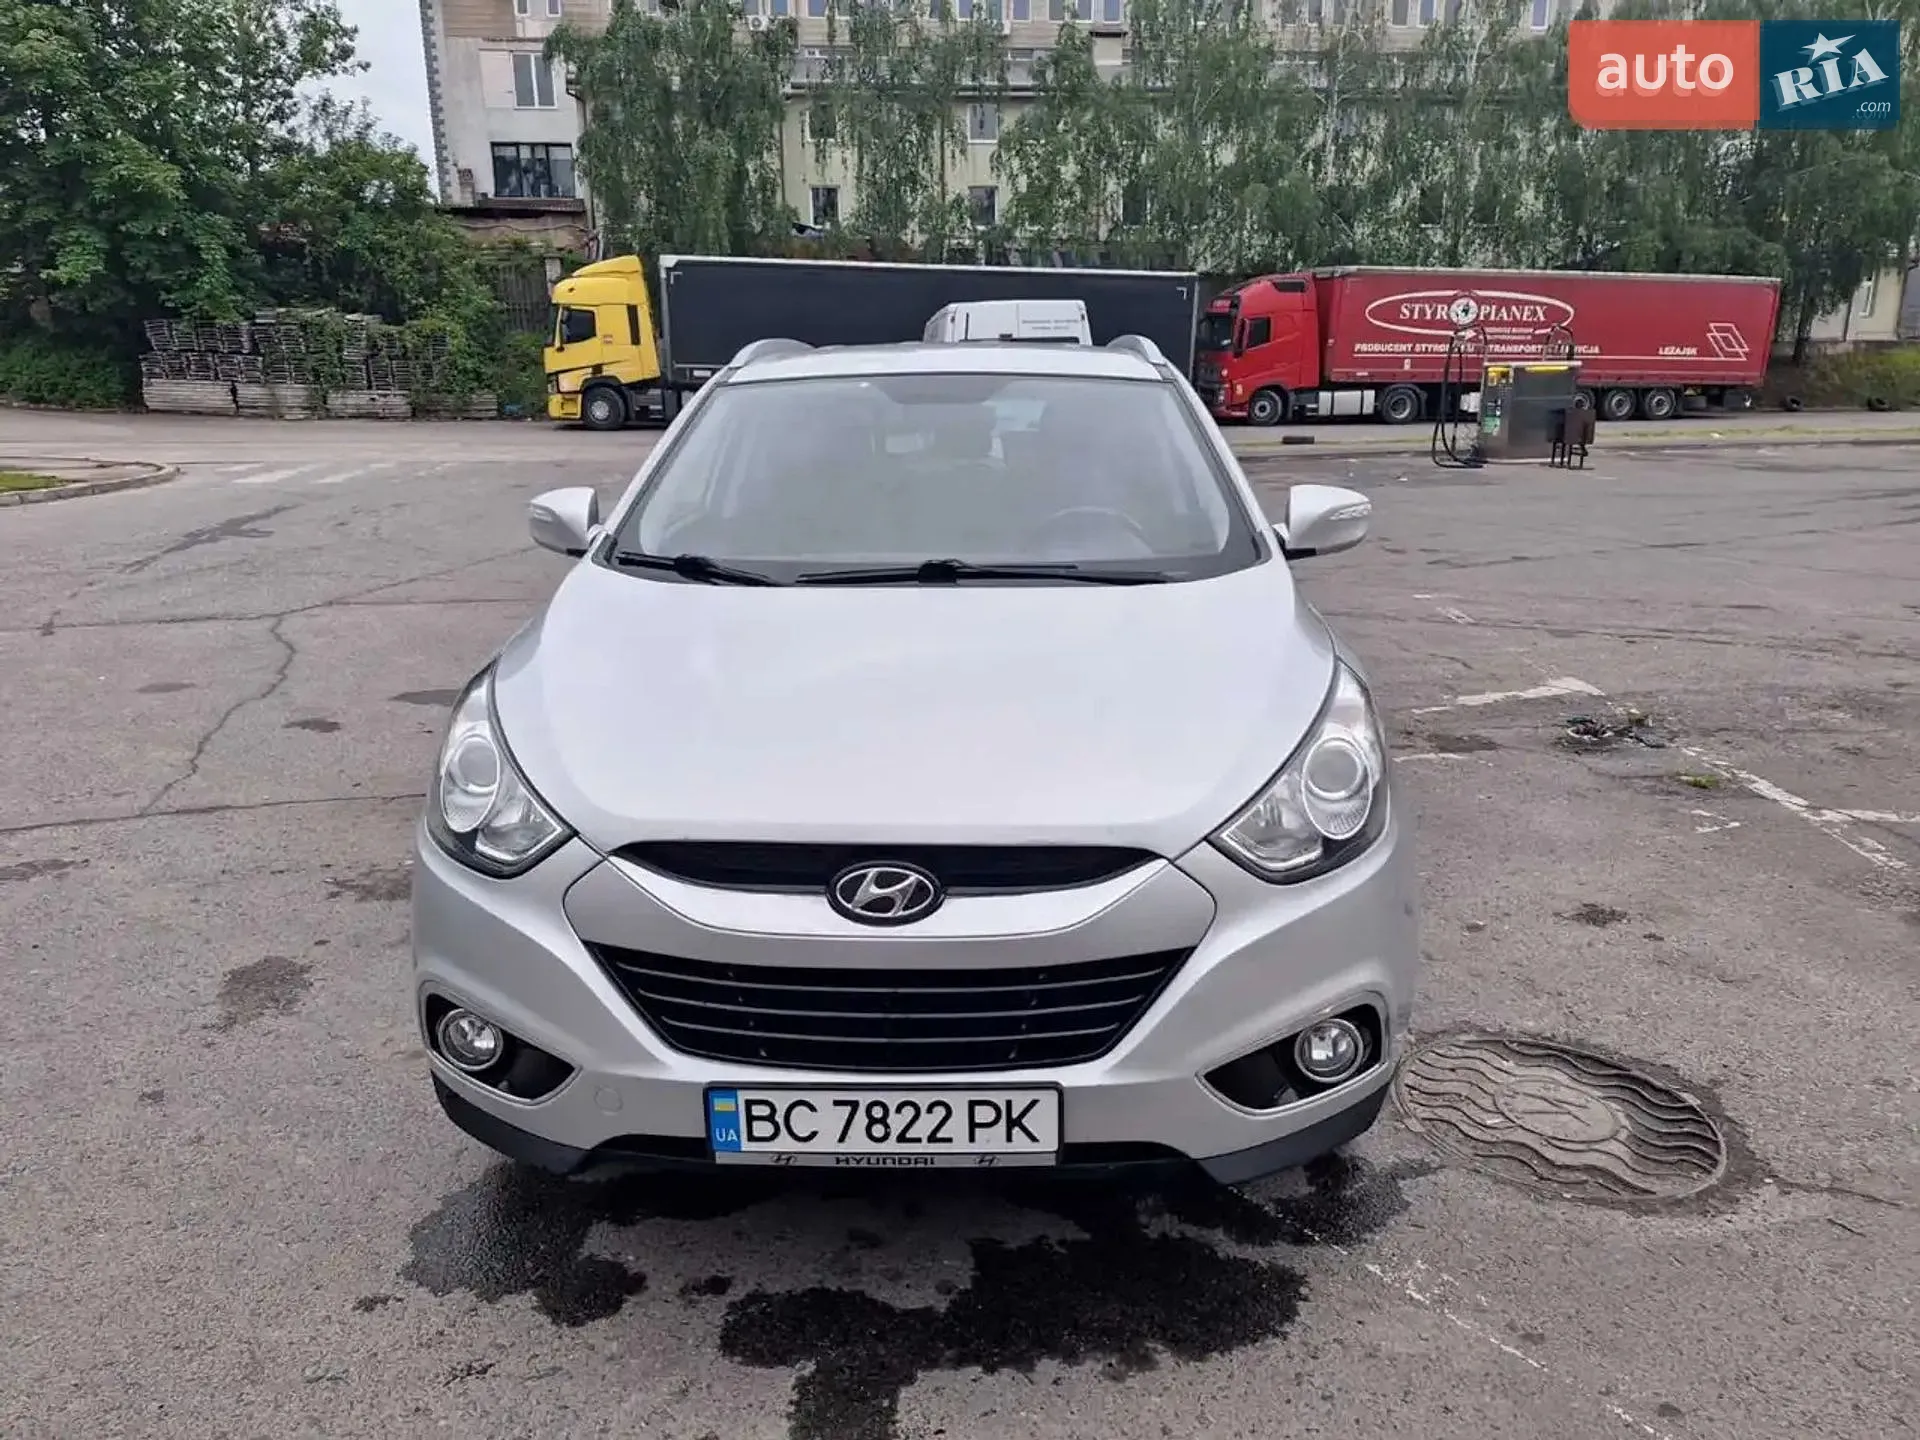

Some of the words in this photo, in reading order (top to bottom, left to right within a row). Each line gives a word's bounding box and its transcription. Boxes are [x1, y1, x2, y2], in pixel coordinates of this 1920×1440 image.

[744, 1099, 819, 1143] BC
[832, 1100, 954, 1143] 7822
[967, 1099, 1040, 1143] PK
[716, 1129, 738, 1142] UA
[835, 1156, 936, 1166] HYUNDAI
